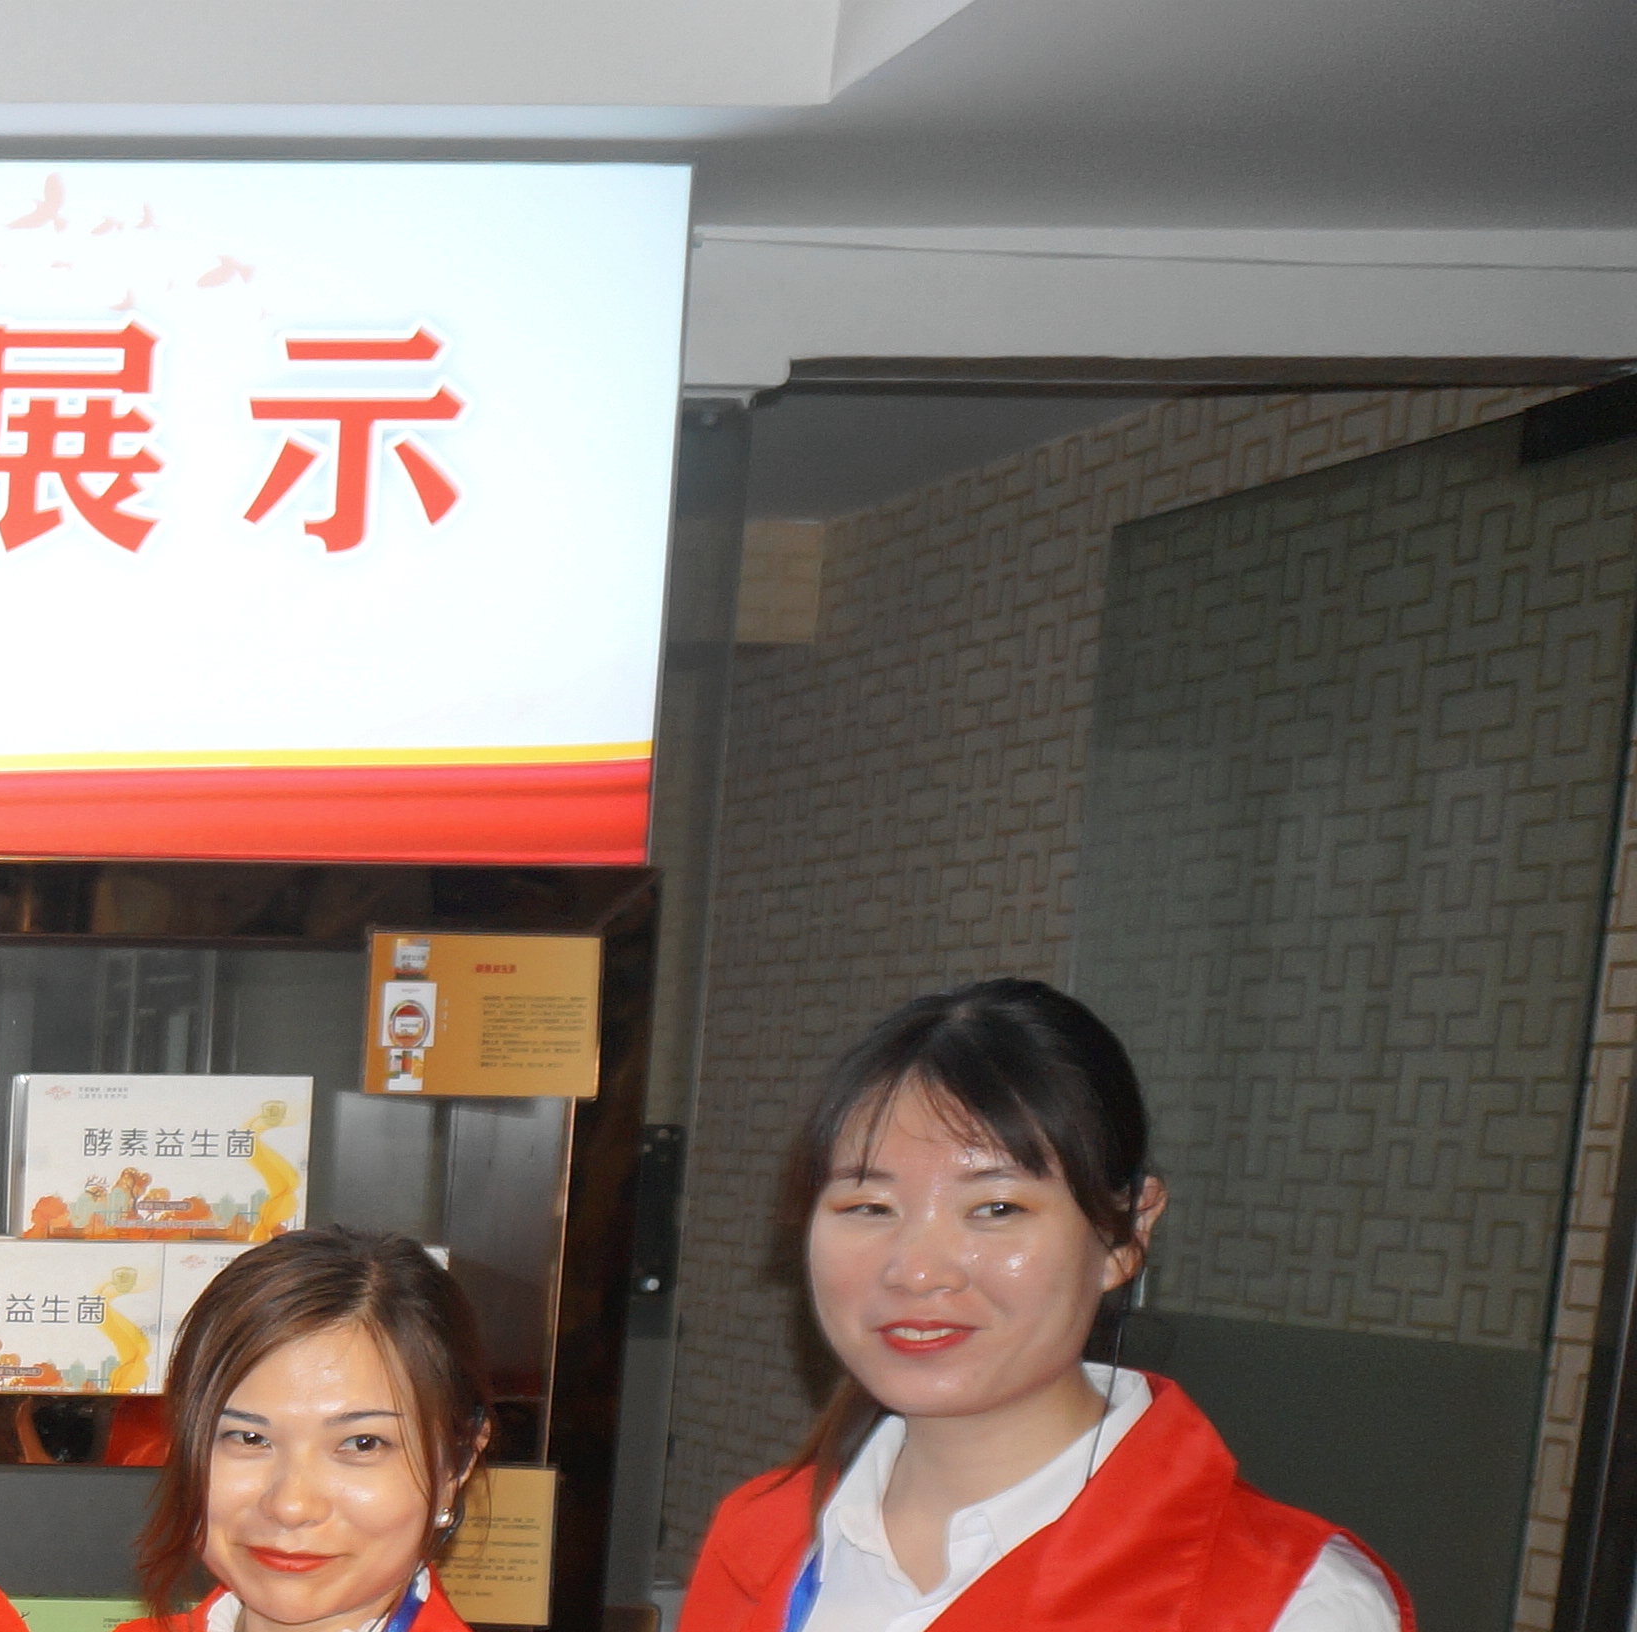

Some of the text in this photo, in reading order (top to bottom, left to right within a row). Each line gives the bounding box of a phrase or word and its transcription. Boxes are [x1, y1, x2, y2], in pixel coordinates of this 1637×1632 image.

[83, 1127, 256, 1159] 酵素益生菌
